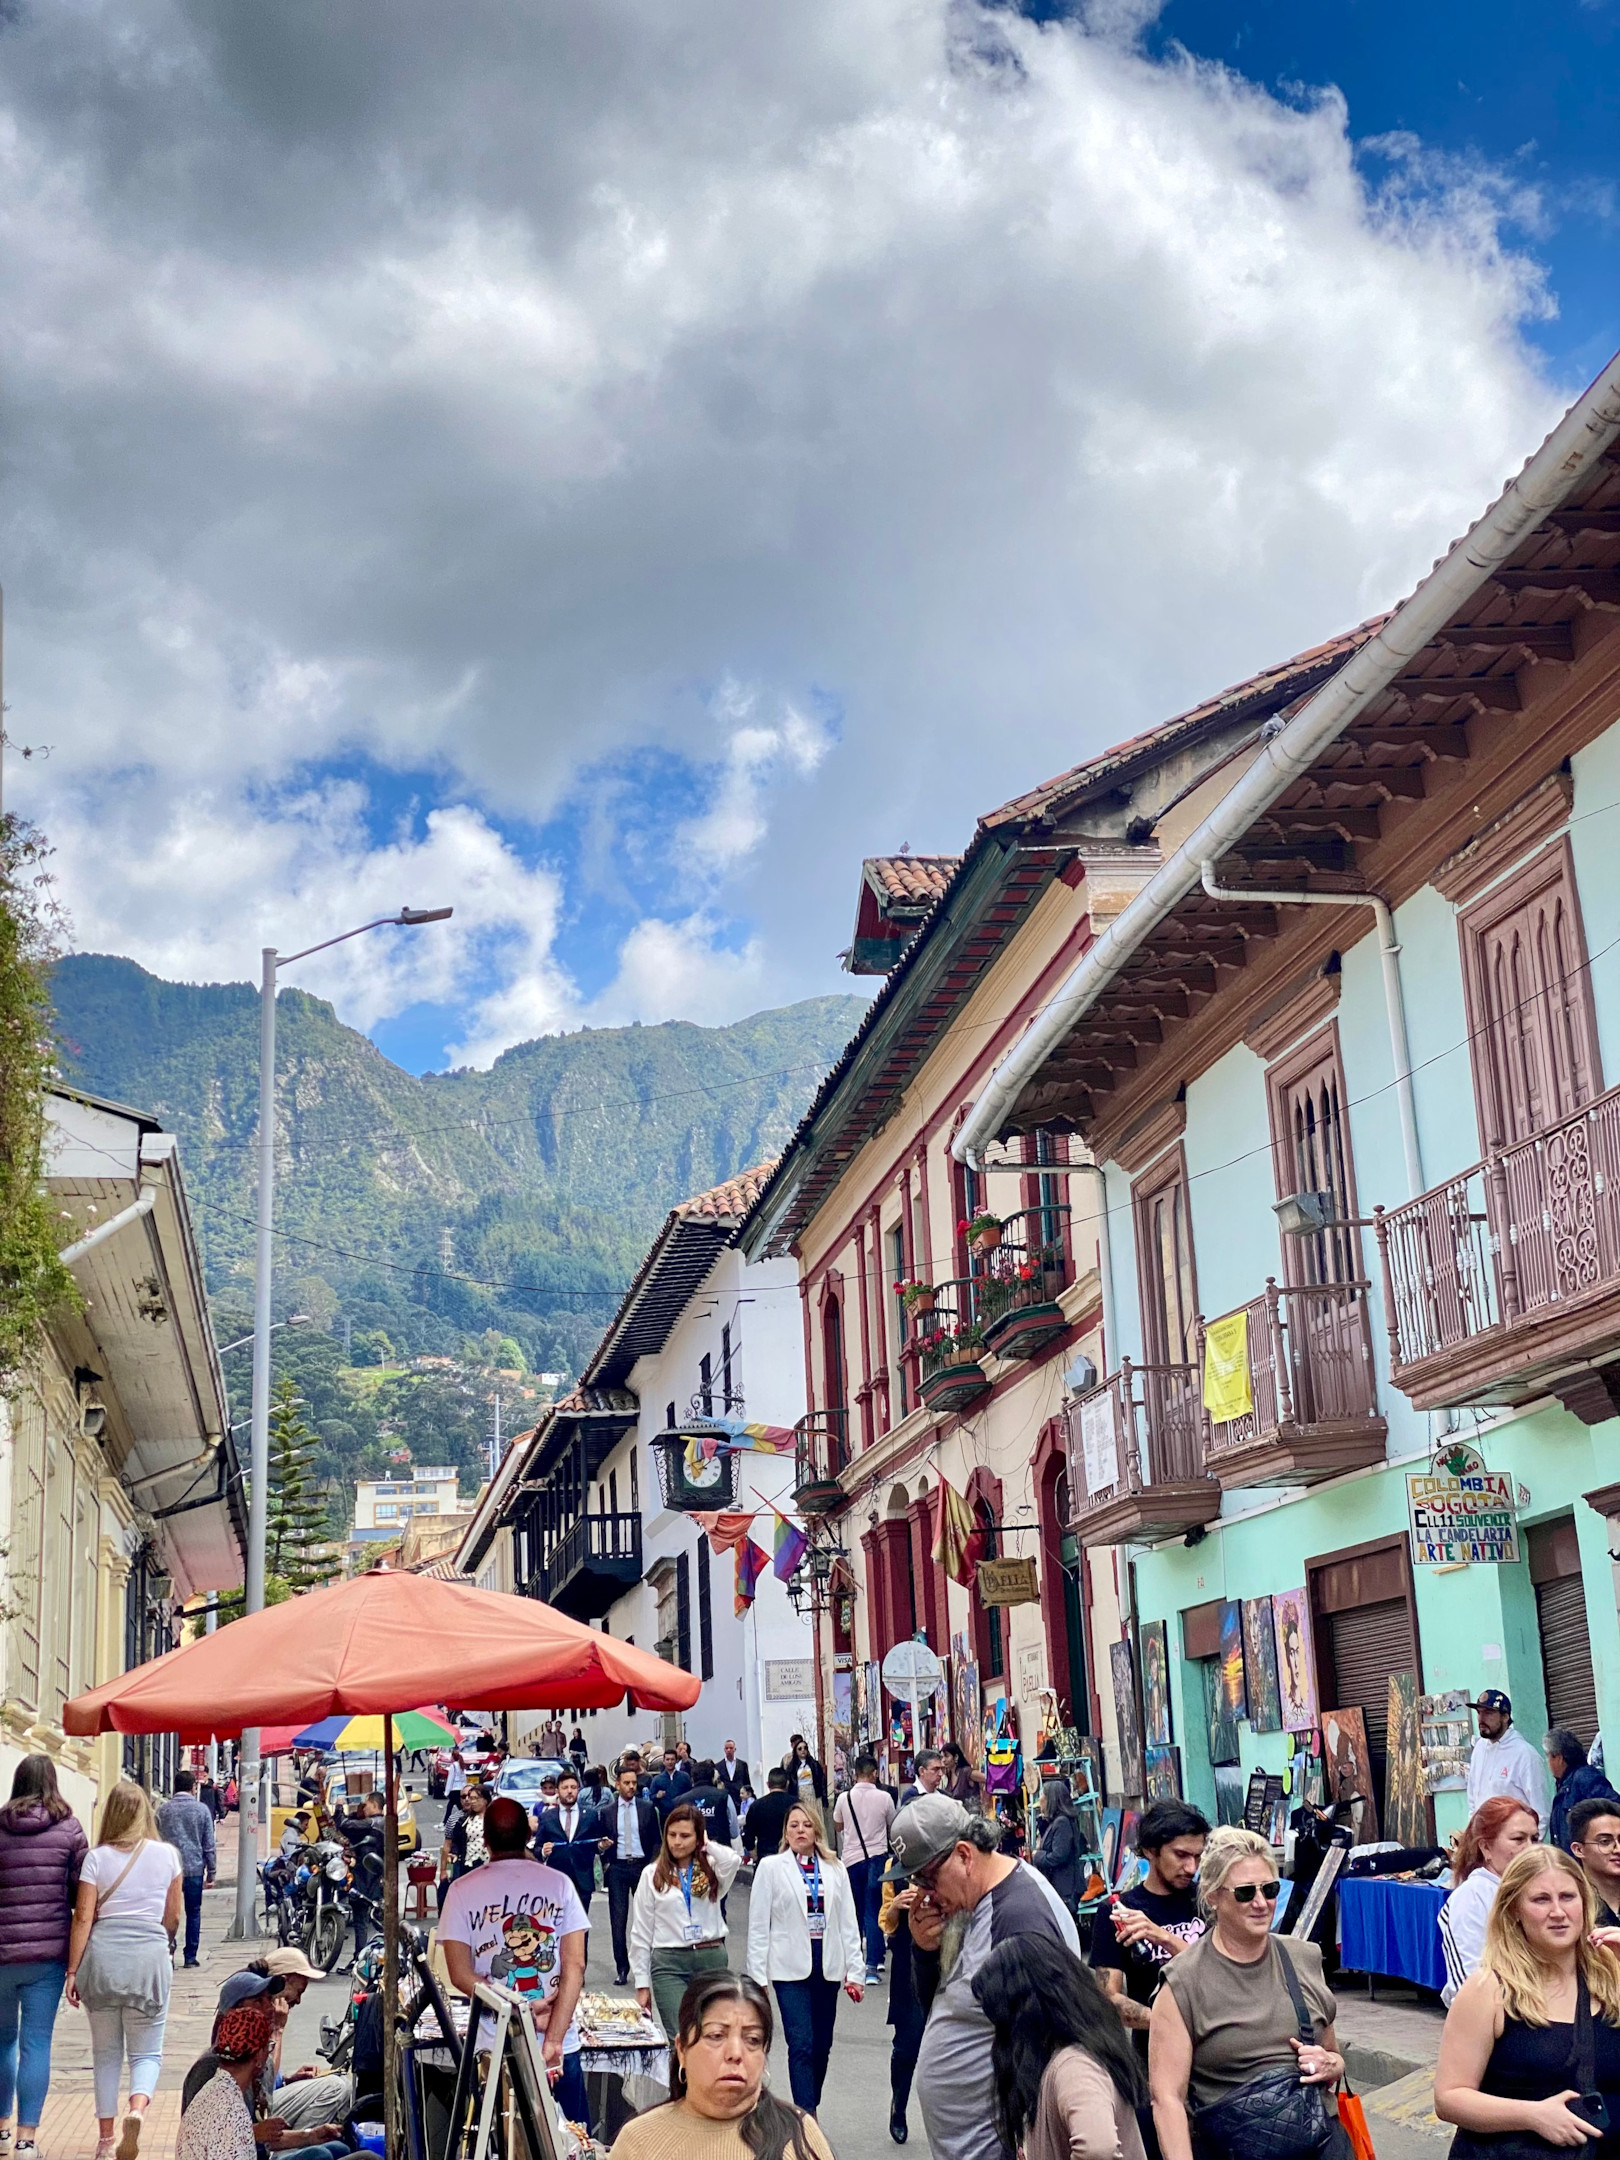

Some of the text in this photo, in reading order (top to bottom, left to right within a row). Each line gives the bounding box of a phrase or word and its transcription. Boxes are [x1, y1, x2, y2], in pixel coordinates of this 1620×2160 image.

[1411, 1477, 1509, 1500] COLOMBIA
[1415, 1492, 1505, 1514] BOGOTA
[1456, 1512, 1512, 1527] SOUVENIR
[1416, 1527, 1513, 1543] LA CANDELARIA
[1419, 1542, 1514, 1561] ARTE NATIVO
[469, 1893, 564, 1931] WELCOME
